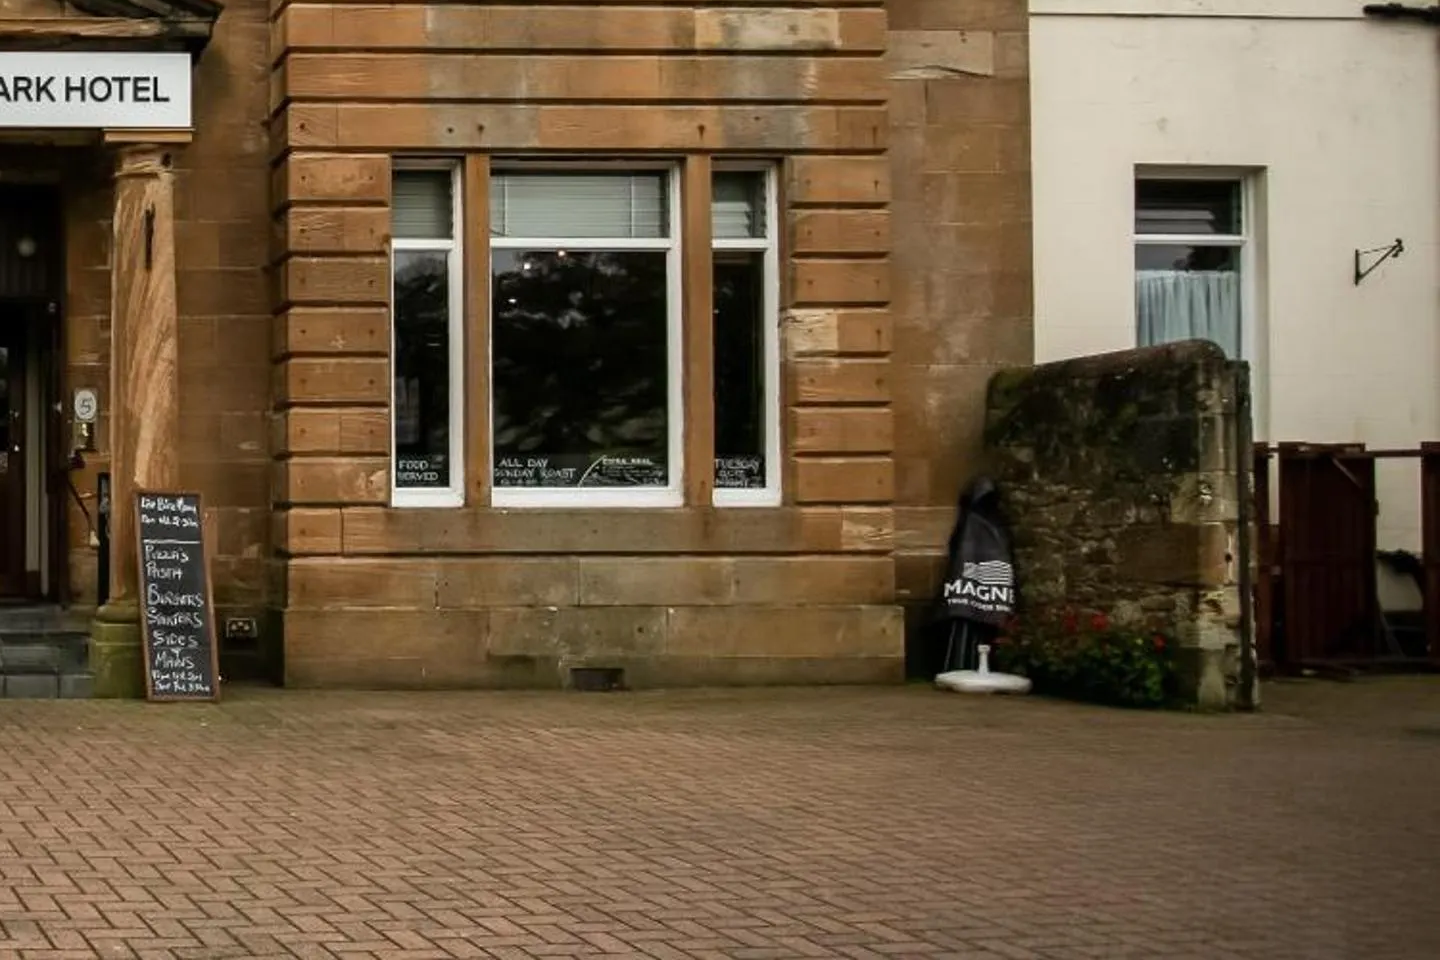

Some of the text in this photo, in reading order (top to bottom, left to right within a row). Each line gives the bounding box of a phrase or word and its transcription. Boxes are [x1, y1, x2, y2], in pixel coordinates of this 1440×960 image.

[65, 76, 170, 102] HOTEL
[398, 460, 429, 470] FOOD
[499, 458, 549, 468] ALL DAY
